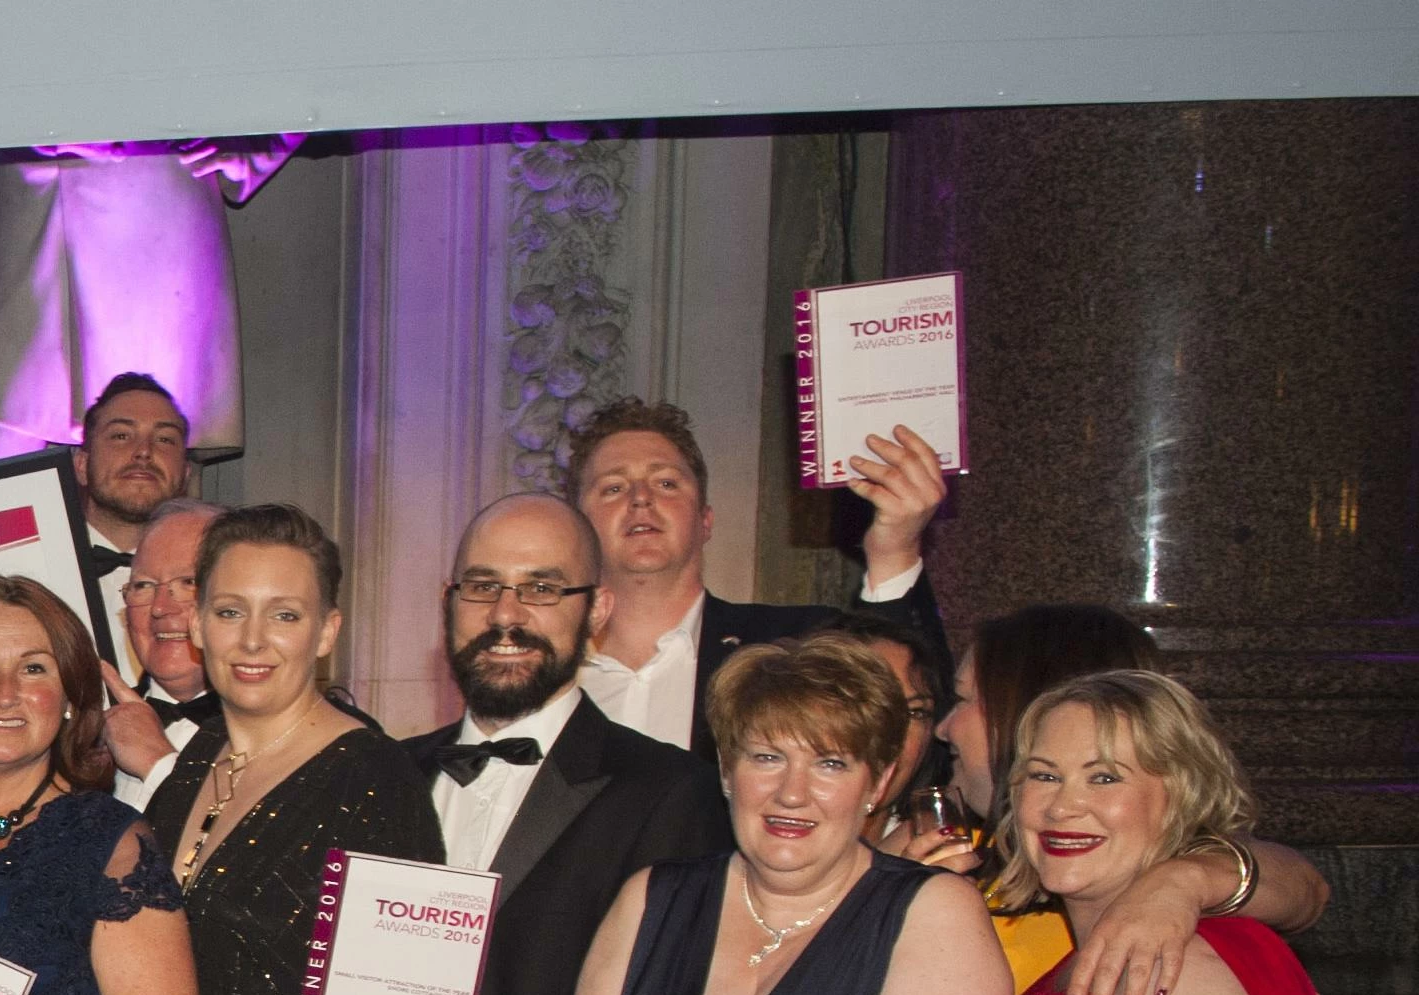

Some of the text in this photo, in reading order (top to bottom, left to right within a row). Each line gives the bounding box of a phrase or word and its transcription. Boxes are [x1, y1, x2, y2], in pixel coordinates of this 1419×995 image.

[849, 310, 953, 337] TOURISM
[853, 330, 954, 351] AWARDS 2016
[797, 301, 817, 476] WINNER 2016
[318, 862, 342, 922] 2016
[429, 897, 487, 911] CITY REGION
[439, 891, 487, 904] LIVERPOOL
[376, 899, 484, 930] TOURISM
[374, 920, 481, 945] AWARDS 2016
